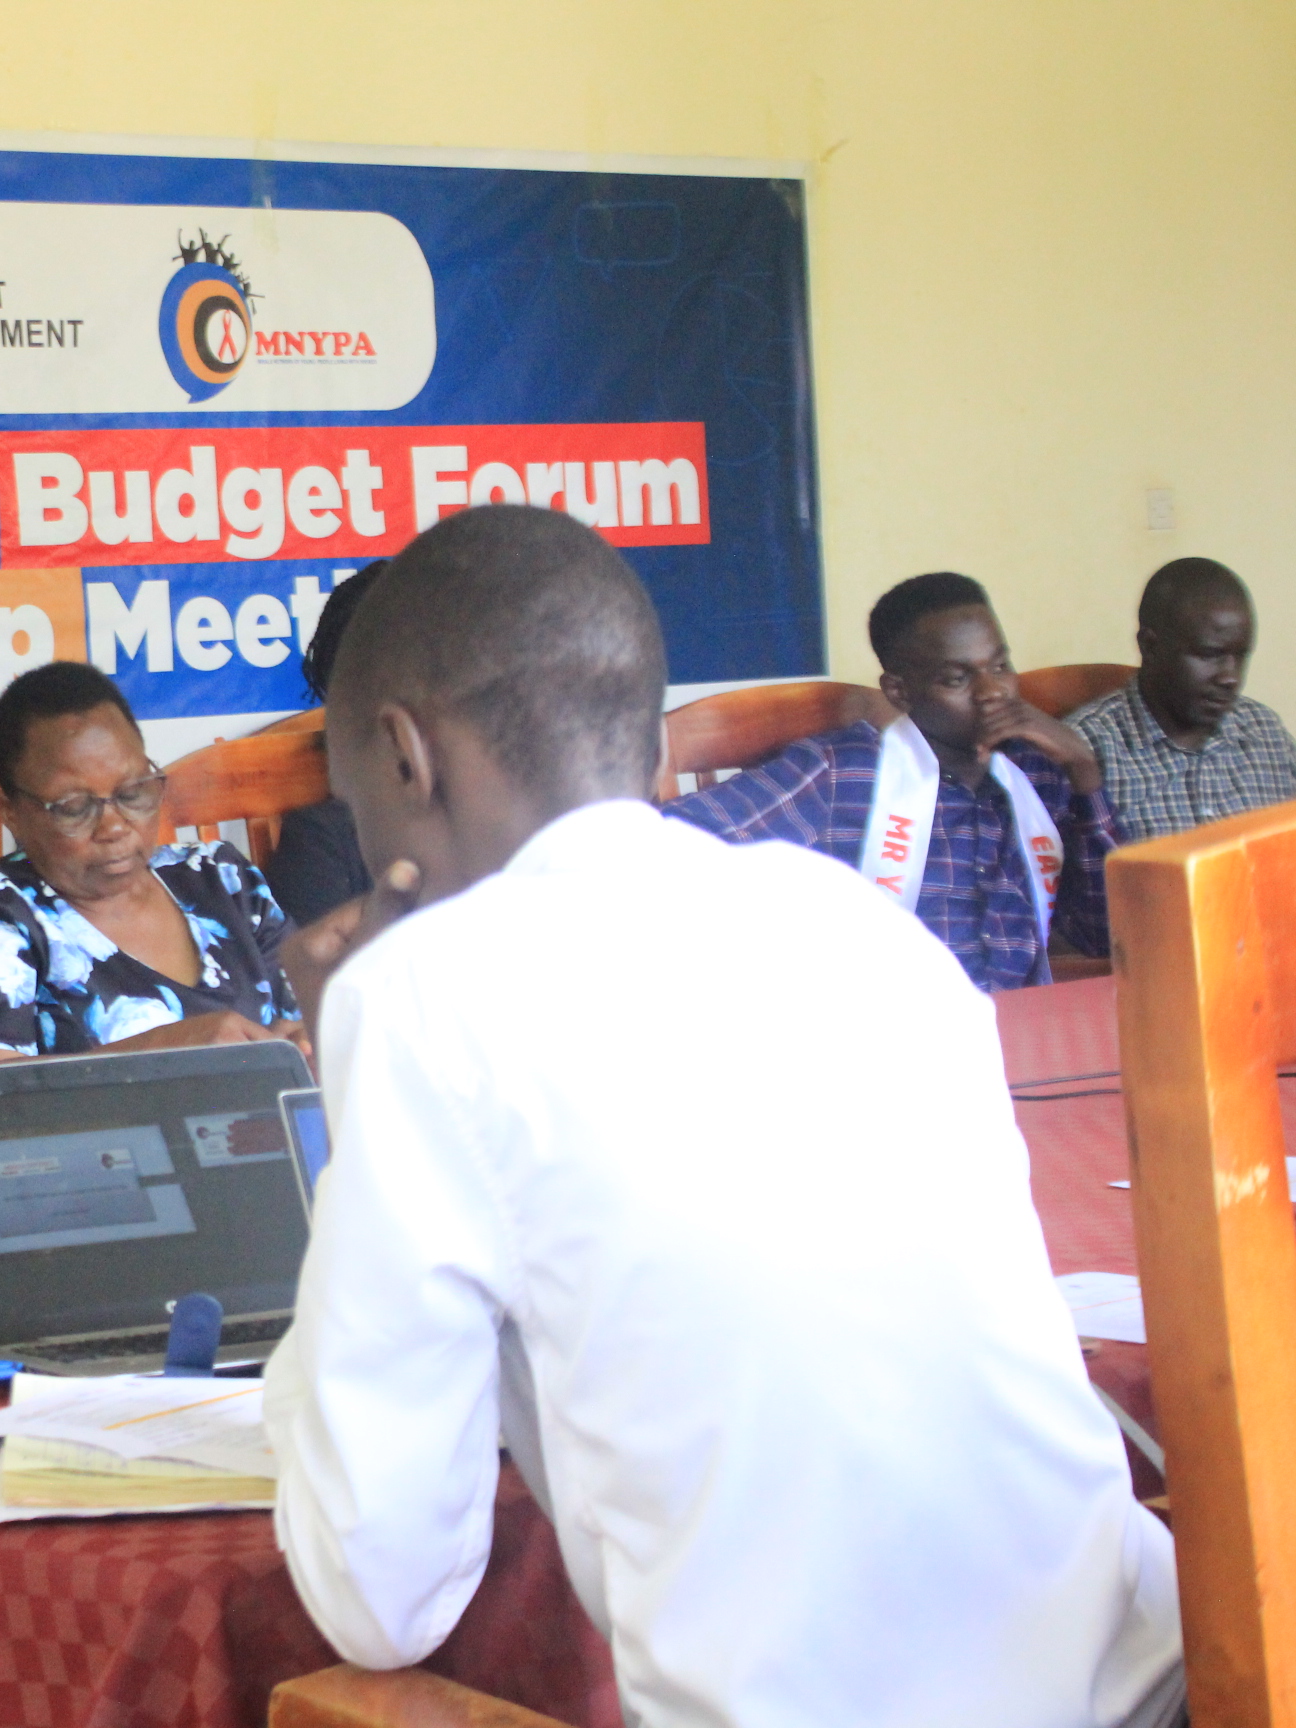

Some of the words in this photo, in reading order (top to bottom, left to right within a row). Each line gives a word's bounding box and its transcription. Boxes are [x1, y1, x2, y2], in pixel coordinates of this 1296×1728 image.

[254, 331, 377, 356] MNYPA
[12, 444, 388, 559] Budget
[411, 445, 702, 535] Forum
[84, 568, 357, 676] Meet
[881, 814, 915, 863] MR
